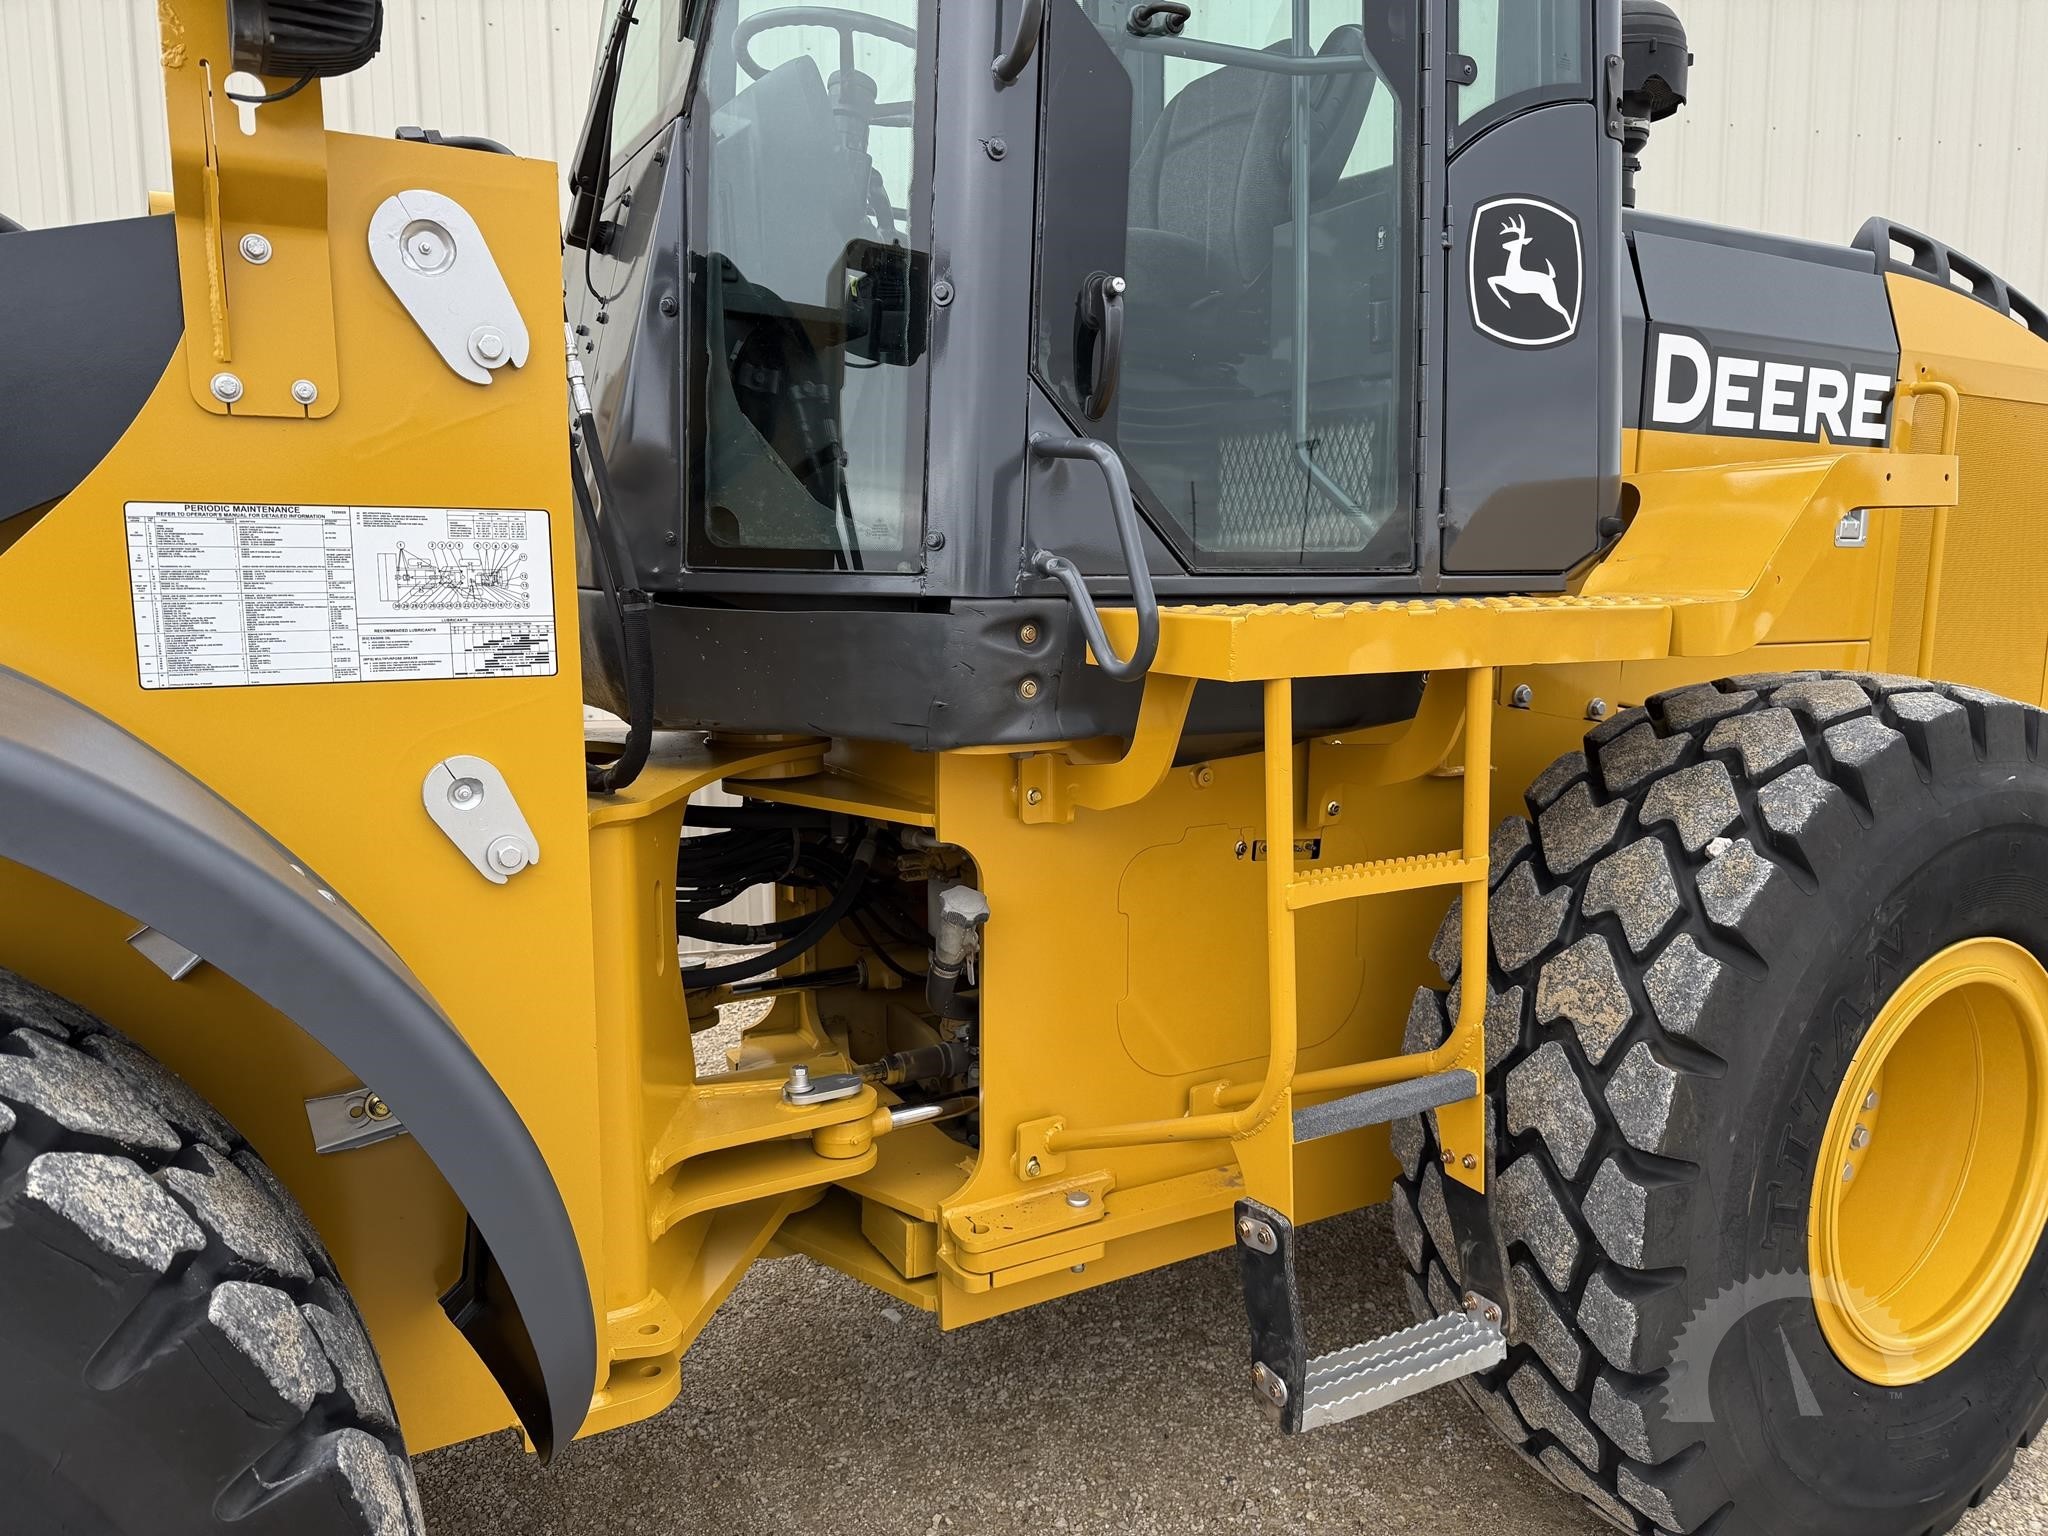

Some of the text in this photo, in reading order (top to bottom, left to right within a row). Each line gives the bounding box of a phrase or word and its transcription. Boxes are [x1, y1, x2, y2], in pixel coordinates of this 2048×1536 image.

[1652, 332, 1892, 440] DEERE
[184, 504, 301, 514] PERIODIC MAINTENANCE
